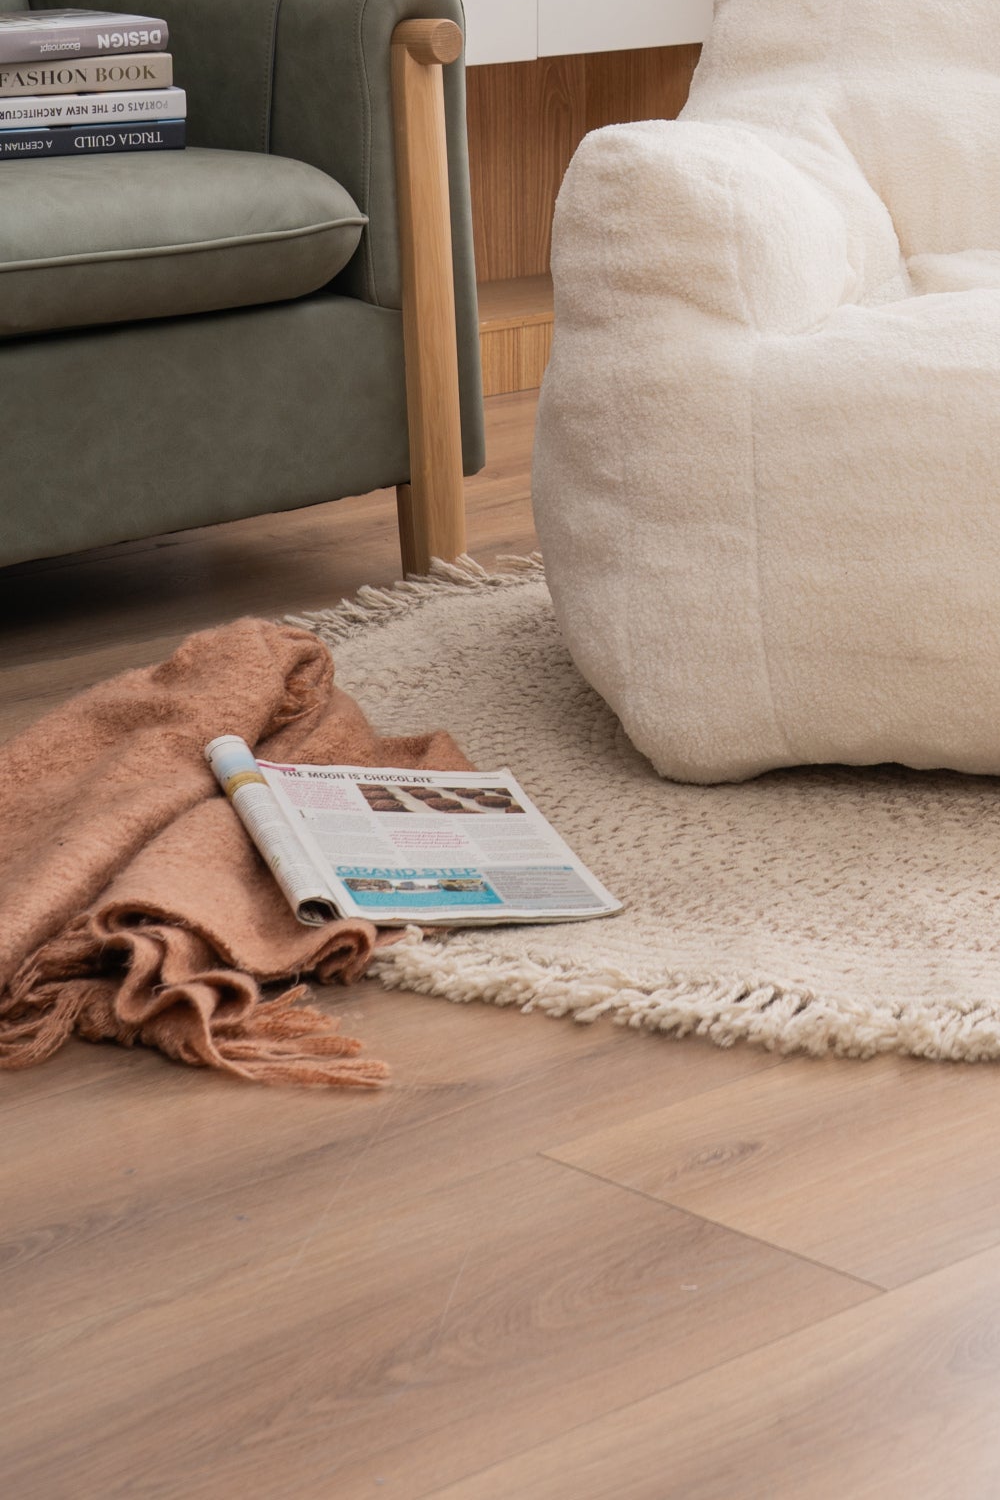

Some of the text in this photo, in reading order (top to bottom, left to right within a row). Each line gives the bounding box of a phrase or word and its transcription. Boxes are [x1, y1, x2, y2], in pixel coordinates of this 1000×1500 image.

[97, 29, 161, 50] DESIGN
[0, 64, 157, 88] FASHON BOOK
[65, 105, 89, 116] NEW
[91, 104, 109, 114] THE
[112, 103, 125, 113] OF
[128, 100, 169, 111] PORTATS
[46, 140, 53, 149] A
[74, 134, 116, 149] GUILD
[119, 131, 164, 146] TRICIA
[4, 140, 44, 152] CERTIAN
[281, 771, 435, 785] THE MOON IS CHOCOLATE
[336, 865, 417, 877] GRAND
